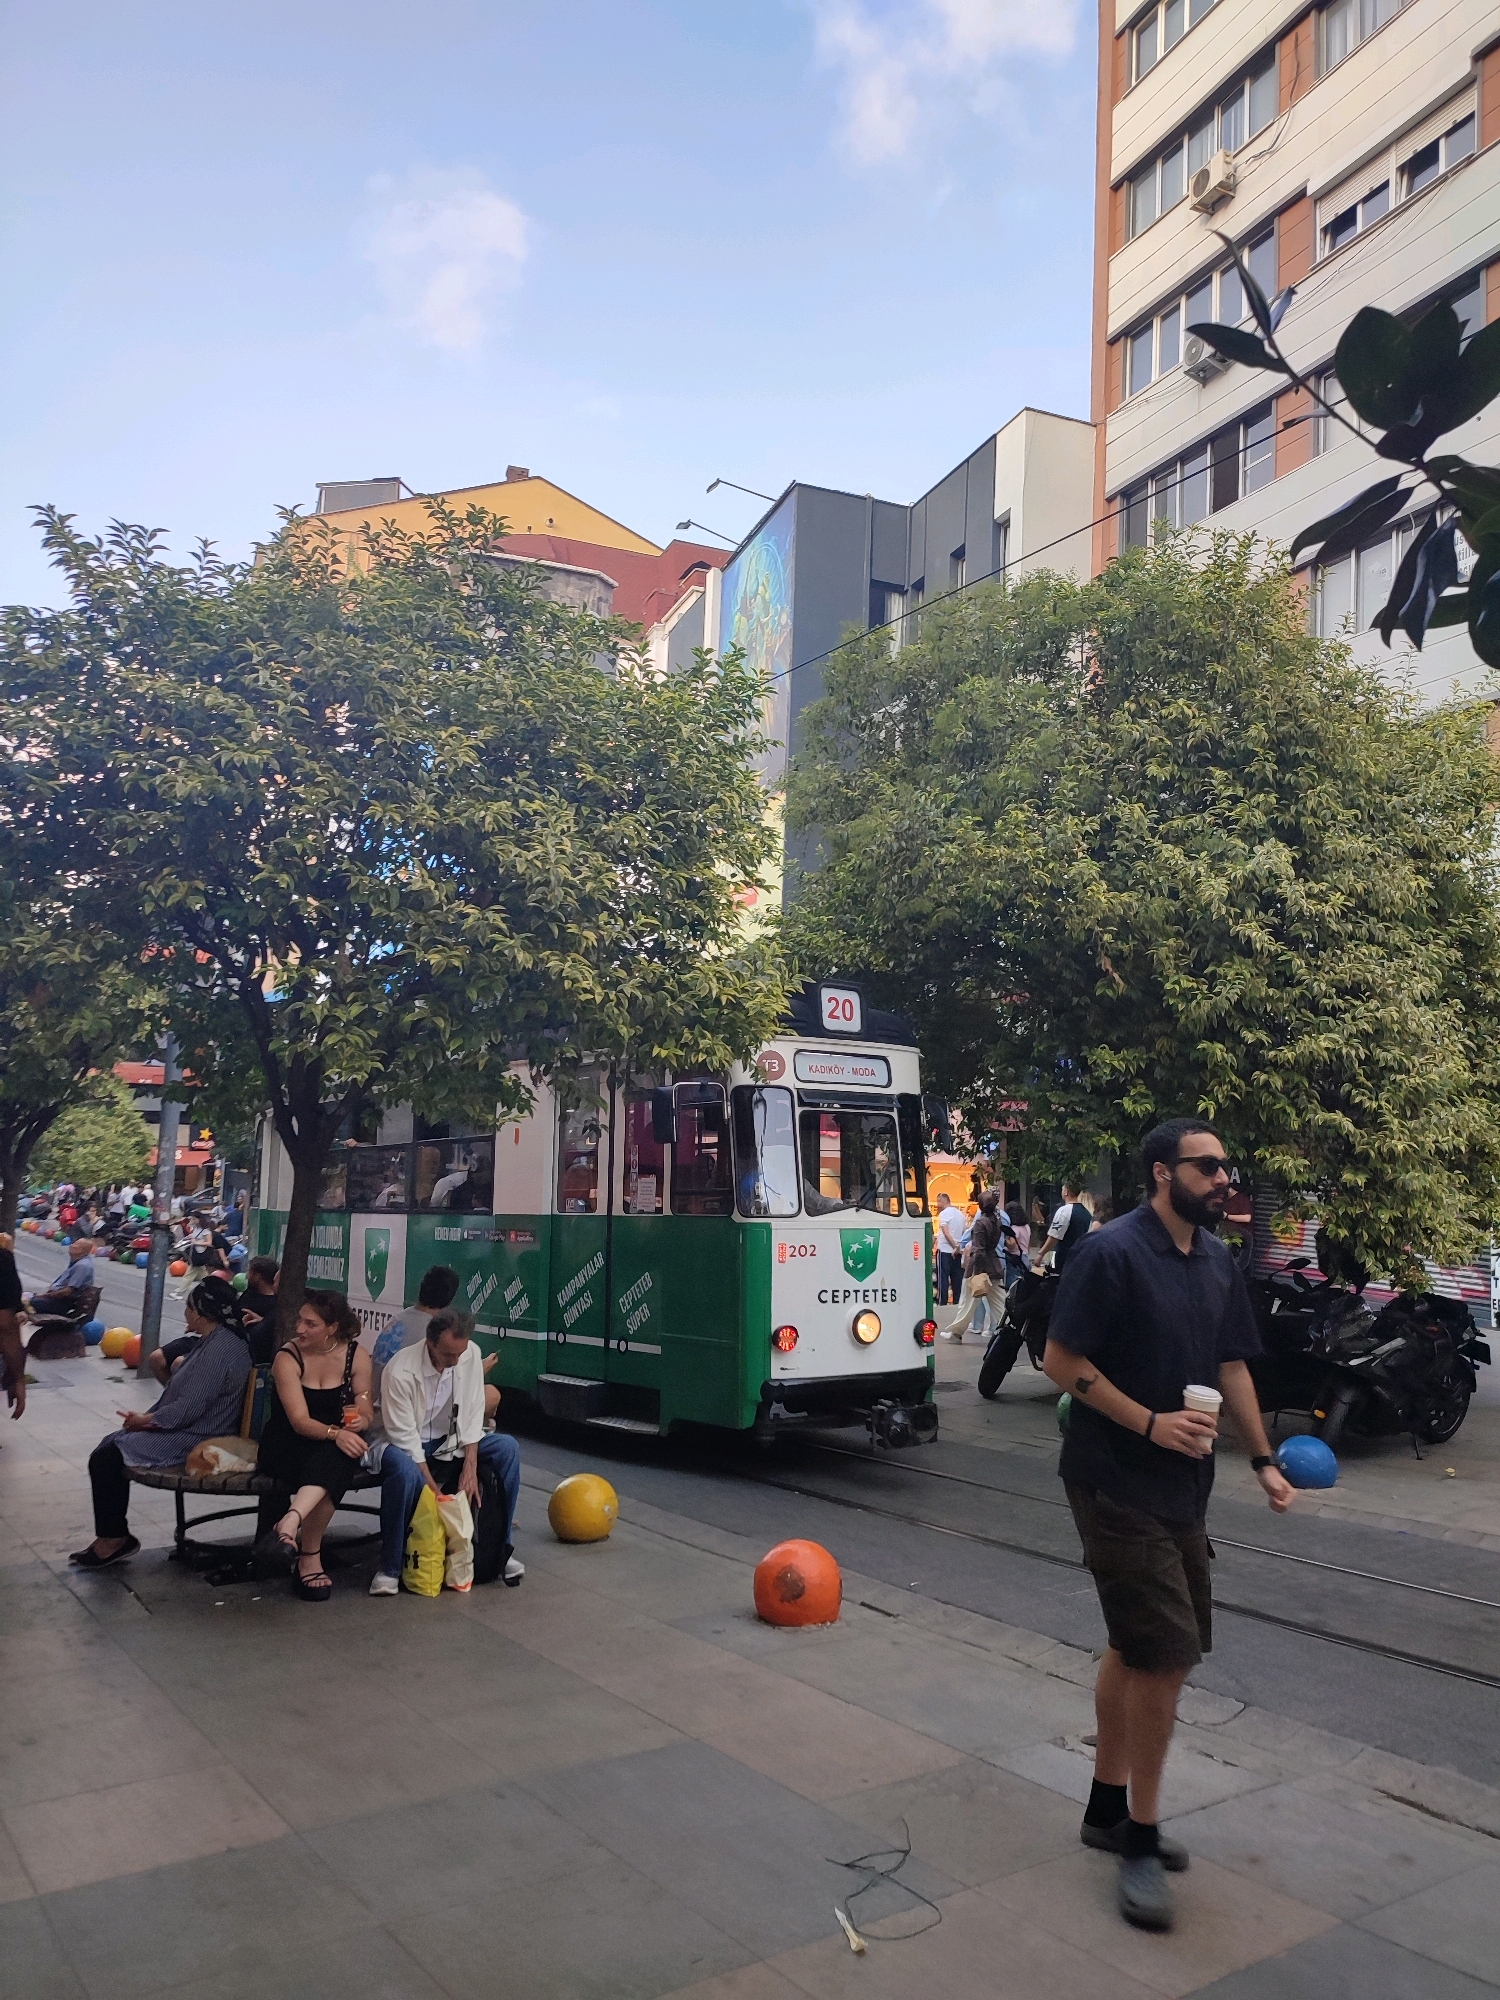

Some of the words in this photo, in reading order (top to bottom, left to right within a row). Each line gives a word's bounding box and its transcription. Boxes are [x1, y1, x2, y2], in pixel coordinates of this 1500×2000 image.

[827, 996, 854, 1022] 20
[763, 1059, 779, 1072] T3
[808, 1064, 845, 1075] KADIKÖY
[851, 1067, 876, 1077] MODA
[788, 1244, 817, 1258] 202
[557, 1251, 605, 1308] KAMPANYALAR
[619, 1271, 653, 1314] CEPTETEB
[563, 1289, 594, 1329] DÜNYASI
[817, 1288, 898, 1304] CEPTETEB
[626, 1302, 651, 1335] SÜPER
